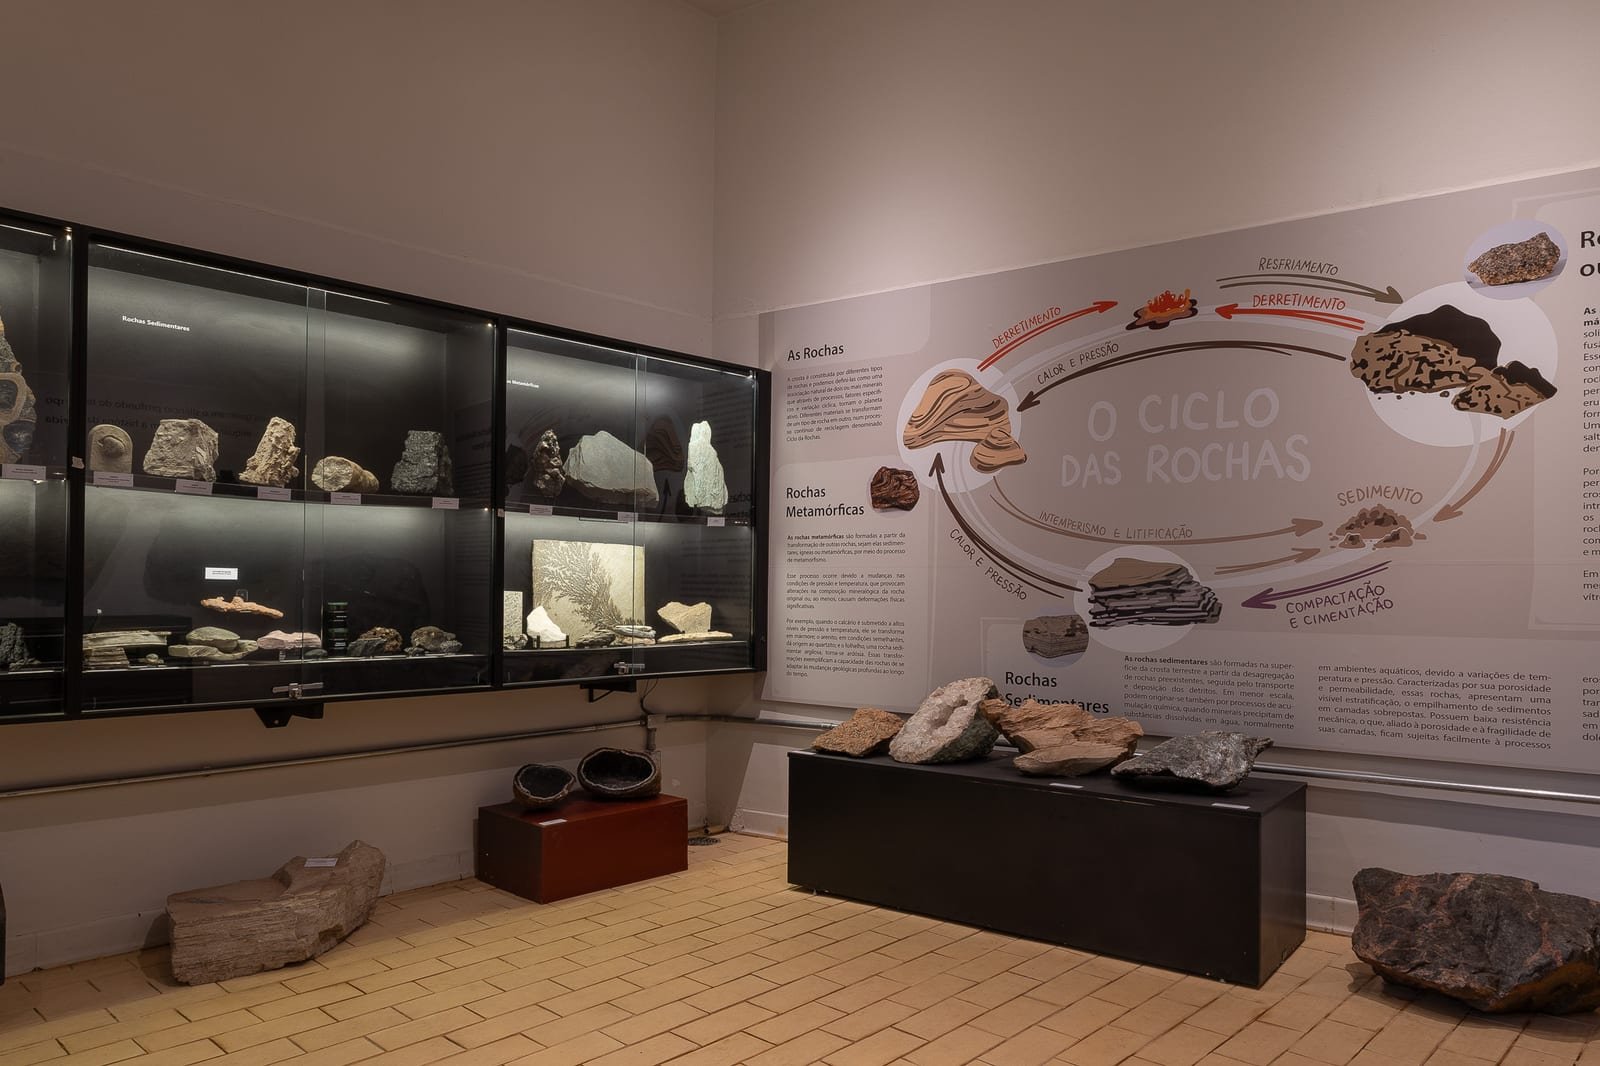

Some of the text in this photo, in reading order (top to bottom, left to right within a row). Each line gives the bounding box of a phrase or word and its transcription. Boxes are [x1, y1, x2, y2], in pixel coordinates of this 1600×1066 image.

[1258, 256, 1338, 276] RESFRIAMENTO
[1252, 292, 1346, 310] DERRETIMENTO
[122, 315, 190, 332] Rochas Sedimentares
[992, 306, 1062, 348] DERRETIMENTO
[787, 344, 844, 362] As Rochas
[1037, 340, 1119, 385] CALOR E PRESSÃO
[1088, 386, 1280, 442] O CICLO
[1061, 434, 1312, 488] DAS ROCHAS
[786, 486, 826, 499] Rochas
[1336, 484, 1423, 507] SEDIMENTO
[786, 503, 864, 518] Metamórficas
[1038, 510, 1193, 540] INTEMPERISMO E LITIFICAÇÃO
[949, 527, 976, 558] CALOR
[986, 566, 1027, 602] PRESSÃO
[1583, 570, 1599, 578] Em
[1286, 580, 1385, 614] COMPACTAÇÃO
[1290, 597, 1394, 629] E CIMENTAÇÃO
[1159, 656, 1207, 665] sedimentares
[1223, 659, 1257, 667] formadas
[1005, 671, 1057, 687] Rochas
[1172, 666, 1201, 674] terrestre
[1209, 668, 1228, 678] partir
[1333, 664, 1376, 673] ambientes
[1424, 668, 1455, 676] devido
[1467, 669, 1509, 681] variações
[1512, 671, 1525, 679] de
[1529, 672, 1551, 680] tem-
[1207, 678, 1234, 688] seguida
[1236, 679, 1253, 689] pelo
[1255, 680, 1294, 691] transporte
[1318, 674, 1352, 685] peratura
[1396, 677, 1459, 688] Caracterizadas
[1461, 682, 1476, 691] por
[1498, 682, 1551, 694] porosidade
[1123, 692, 1147, 702] podem
[1148, 693, 1184, 704] originar-se
[1185, 695, 1215, 704] também
[1229, 700, 1265, 709] processos
[1329, 684, 1394, 697] permeabilidade,
[1430, 690, 1460, 701] rochas,
[1468, 692, 1522, 704] apresentam
[1182, 704, 1210, 715] quando
[1211, 706, 1241, 715] minerais
[1243, 708, 1282, 720] precipitam
[1318, 694, 1342, 703] visível
[1413, 699, 1478, 712] empilhamento
[1481, 703, 1493, 711] de
[1496, 704, 1551, 715] sedimentos
[1164, 713, 1201, 722] dissolvidas
[1243, 718, 1294, 729] normalmente
[1334, 705, 1369, 715] camadas
[1373, 707, 1425, 720] sobrepostas.
[1430, 711, 1468, 721] Possuem
[1473, 714, 1497, 722] baixa
[1501, 715, 1551, 726] resistência
[1366, 720, 1384, 728] que,
[1386, 719, 1412, 728] aliado
[1420, 721, 1470, 734] porosidade
[1487, 726, 1536, 738] fragilidade
[1538, 729, 1551, 737] de
[1338, 726, 1376, 738] camadas,
[1380, 729, 1403, 738] ficam
[1407, 731, 1439, 743] sujeitas
[1443, 734, 1490, 744] facilmente
[1504, 740, 1550, 751] processos
